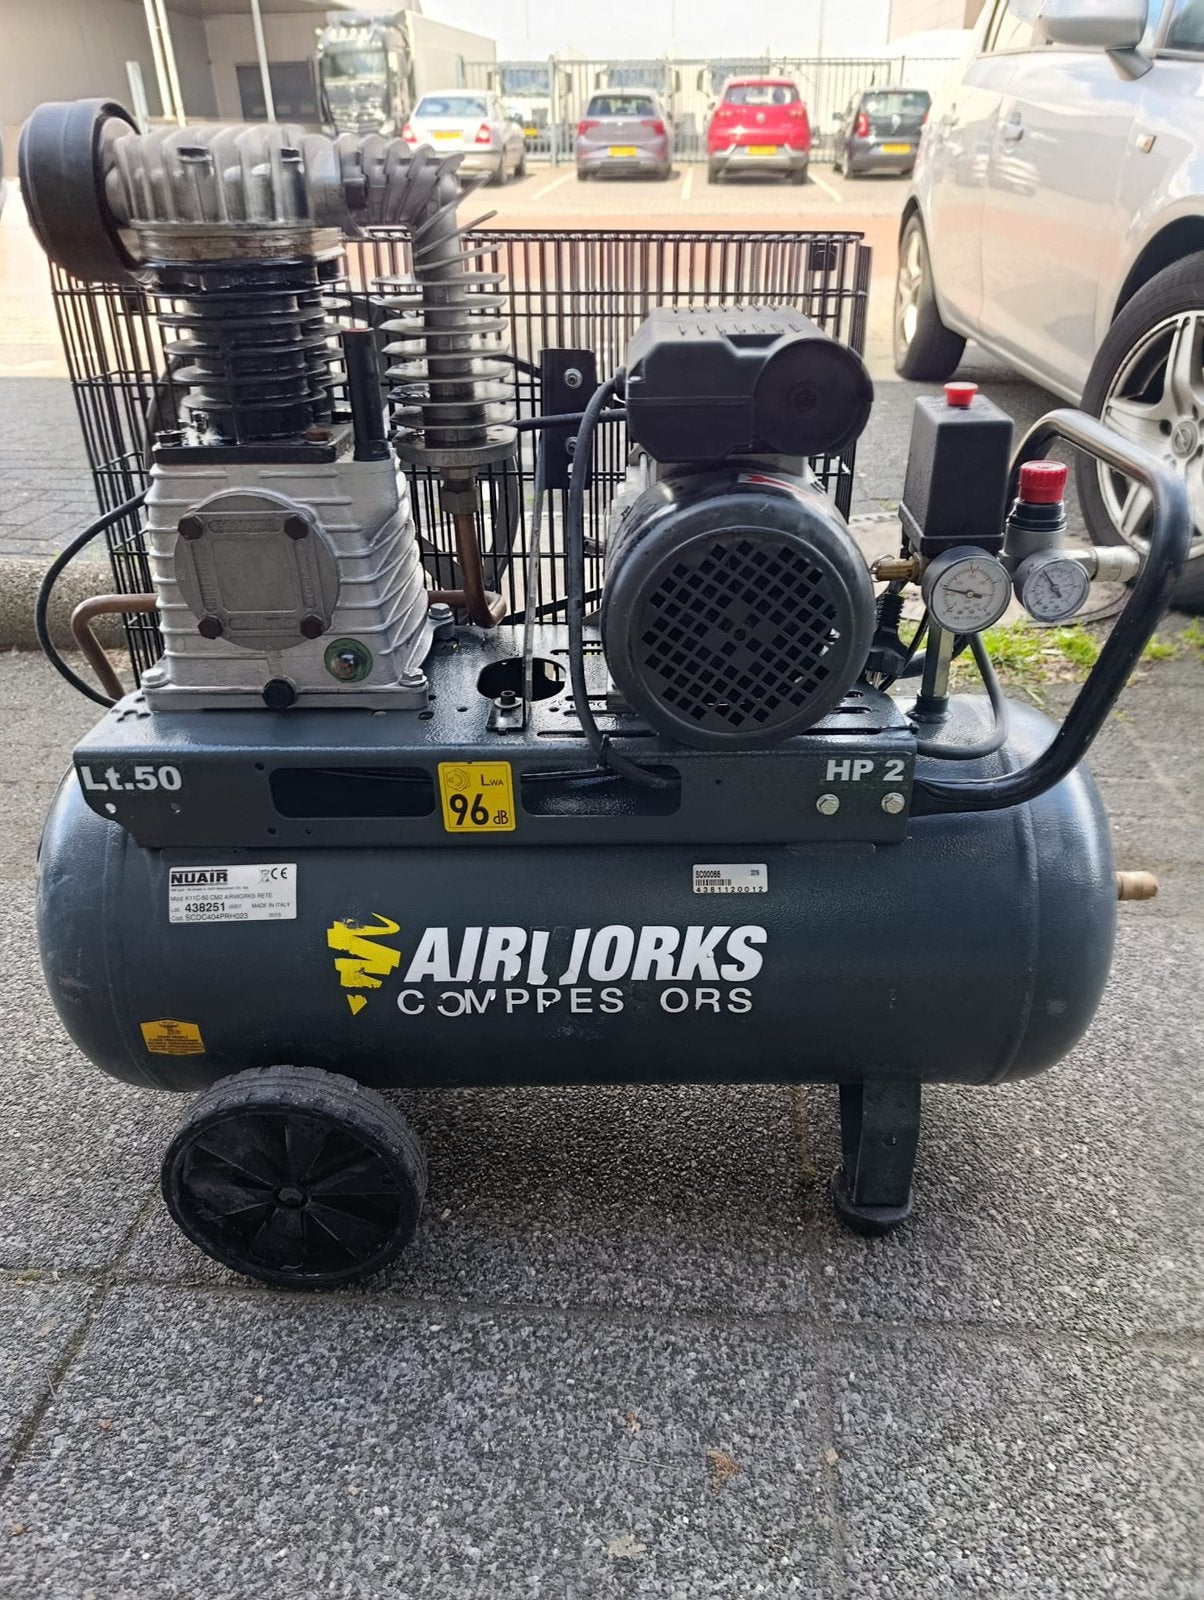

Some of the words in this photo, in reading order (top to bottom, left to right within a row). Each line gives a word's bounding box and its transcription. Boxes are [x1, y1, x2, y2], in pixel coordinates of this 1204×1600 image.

[80, 765, 182, 790] Lt.50
[826, 759, 875, 781] HP
[882, 759, 906, 781] 2
[449, 793, 489, 825] 96
[493, 809, 509, 825] dB
[171, 871, 228, 884] NUAIR
[270, 867, 288, 880] CE
[185, 902, 225, 912] 438251
